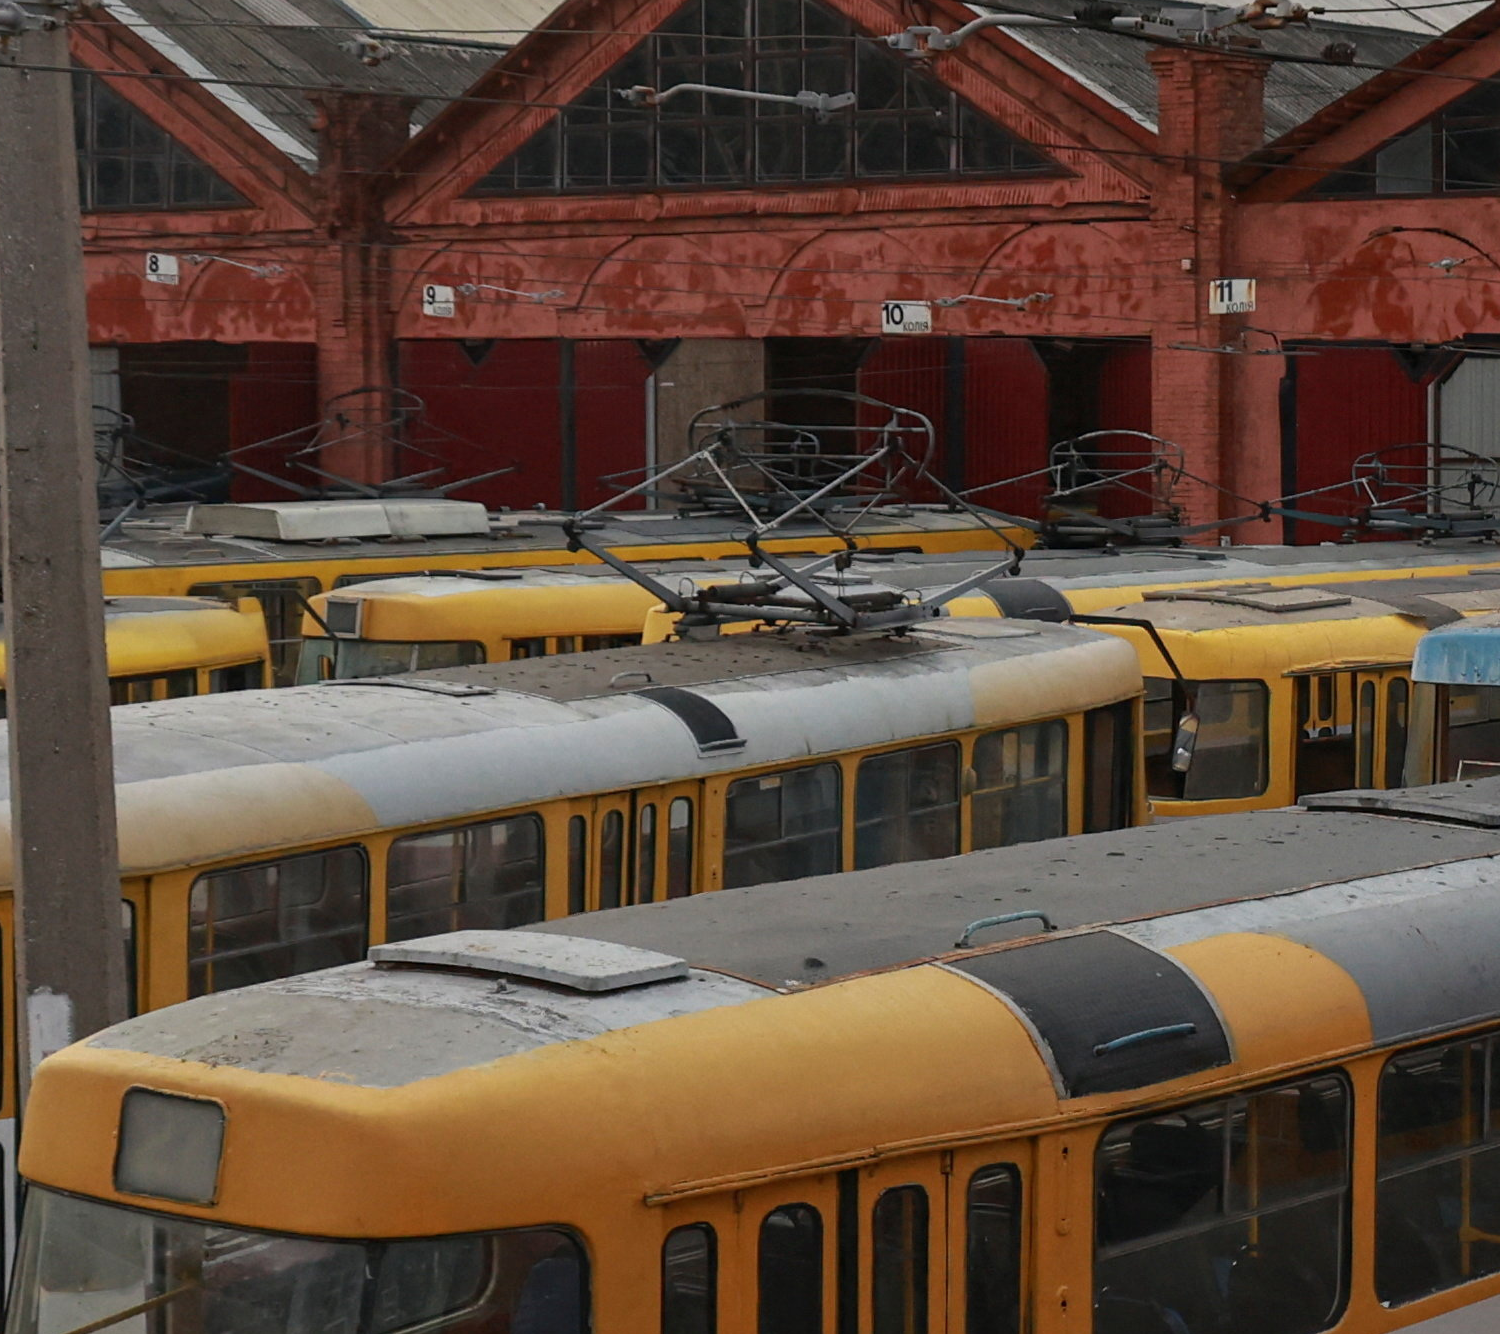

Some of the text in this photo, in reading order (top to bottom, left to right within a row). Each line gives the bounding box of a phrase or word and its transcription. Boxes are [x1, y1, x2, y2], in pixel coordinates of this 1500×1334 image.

[149, 255, 159, 272] 8
[426, 286, 436, 305] 9
[1217, 281, 1233, 302] 11
[882, 304, 904, 325] 10
[1226, 301, 1254, 313] КОЛІЯ
[903, 321, 929, 332] КОЛІЯ
